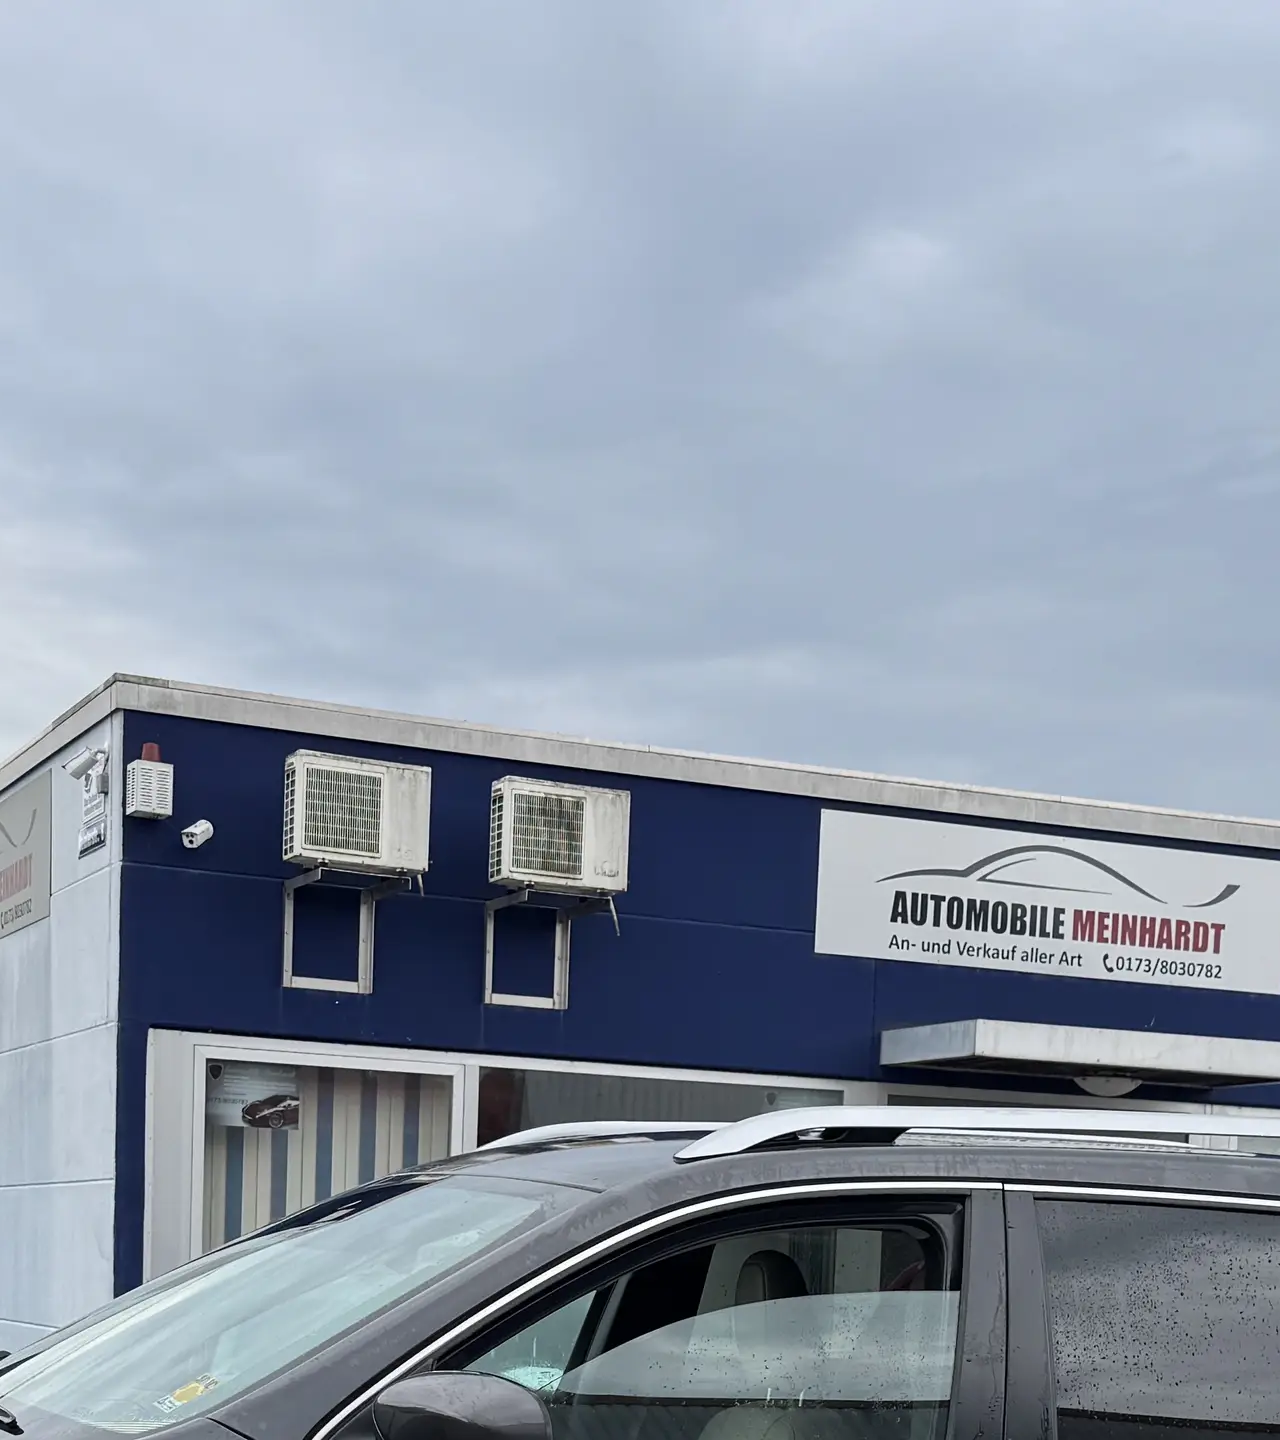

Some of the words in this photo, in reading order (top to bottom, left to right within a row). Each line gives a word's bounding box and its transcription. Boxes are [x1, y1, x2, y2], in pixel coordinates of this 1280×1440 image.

[889, 890, 1066, 940] AUTOMOBILE
[1072, 908, 1226, 955] MEINHARDT
[888, 934, 916, 951] An-
[921, 939, 951, 955] und
[956, 941, 1017, 962] Verkauf
[1021, 948, 1055, 965] aller
[1058, 950, 1083, 968] Art
[1116, 955, 1222, 980] 0173/8030782
